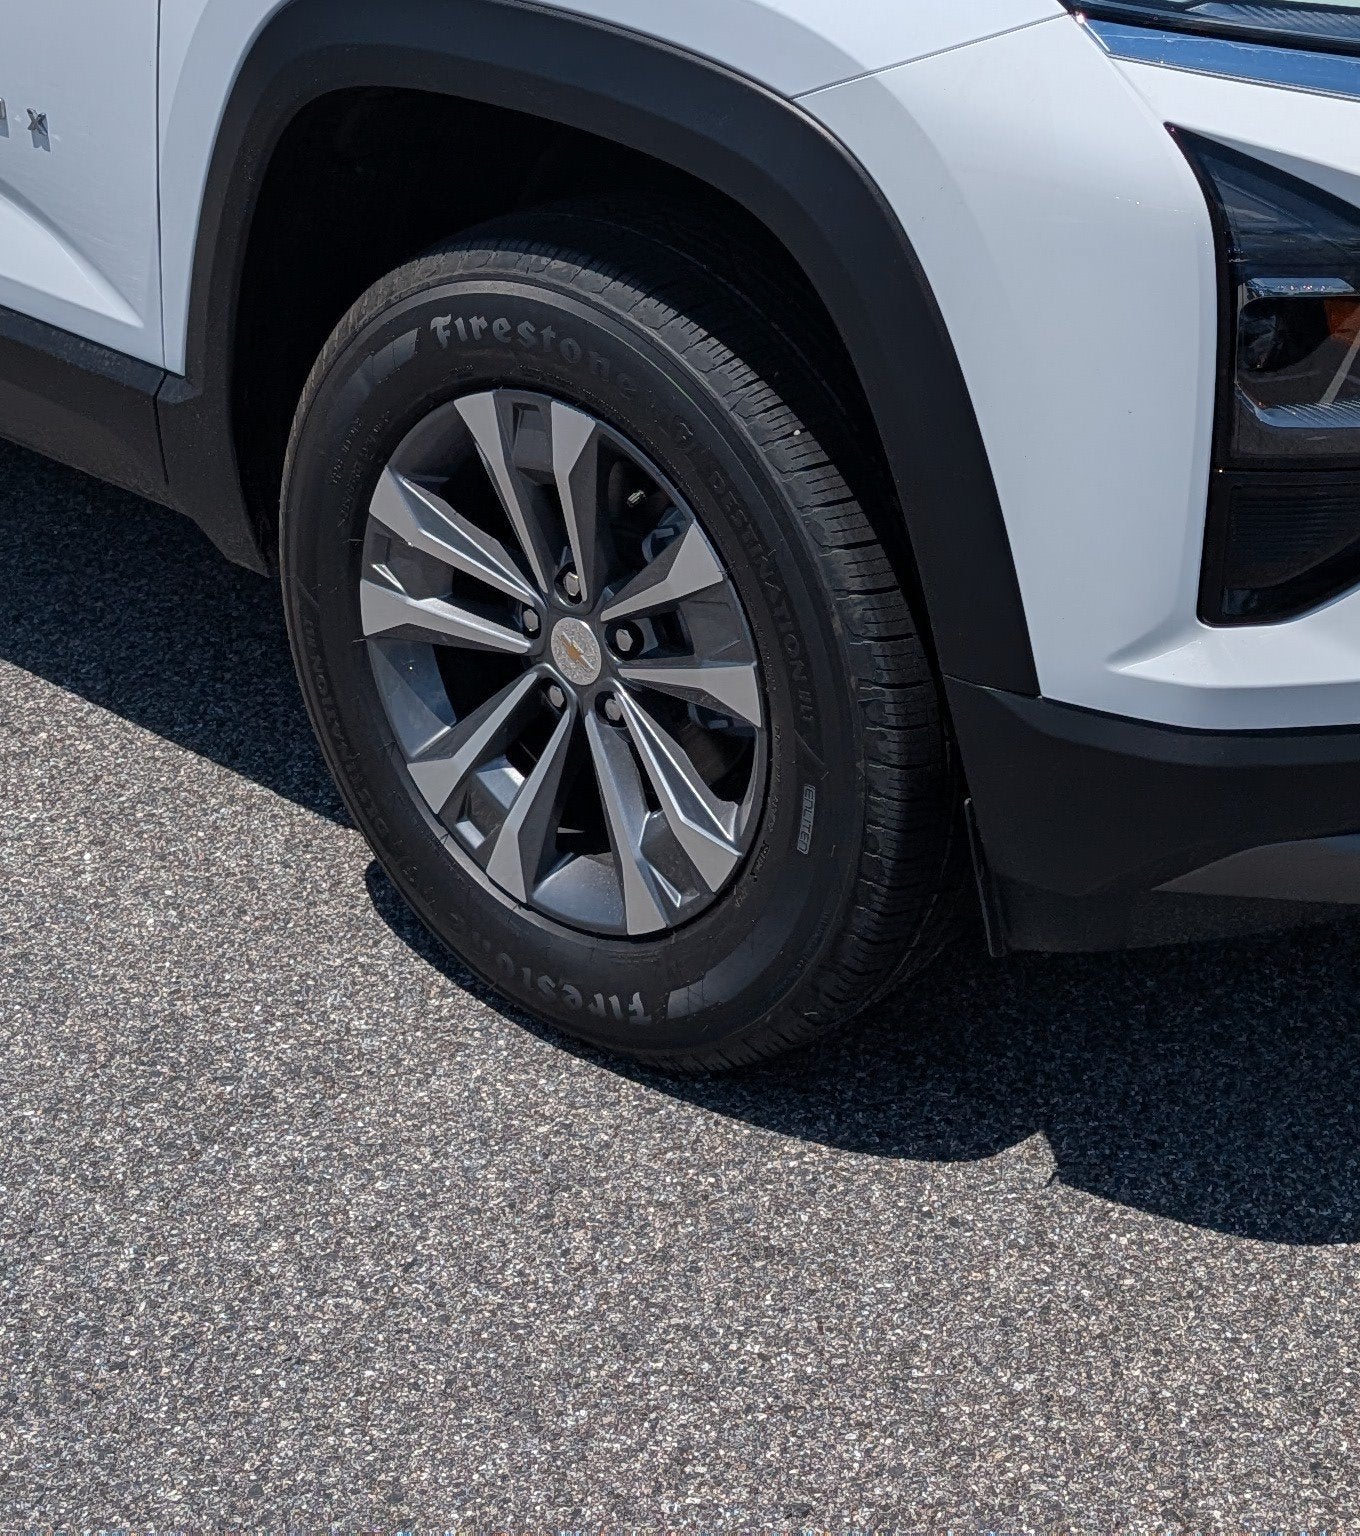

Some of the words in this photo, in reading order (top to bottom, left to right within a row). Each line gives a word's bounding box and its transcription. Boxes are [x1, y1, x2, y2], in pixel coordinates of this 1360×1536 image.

[429, 313, 639, 400] Firestone
[799, 788, 815, 852] ENLITEN
[456, 918, 653, 1025] Firesto
